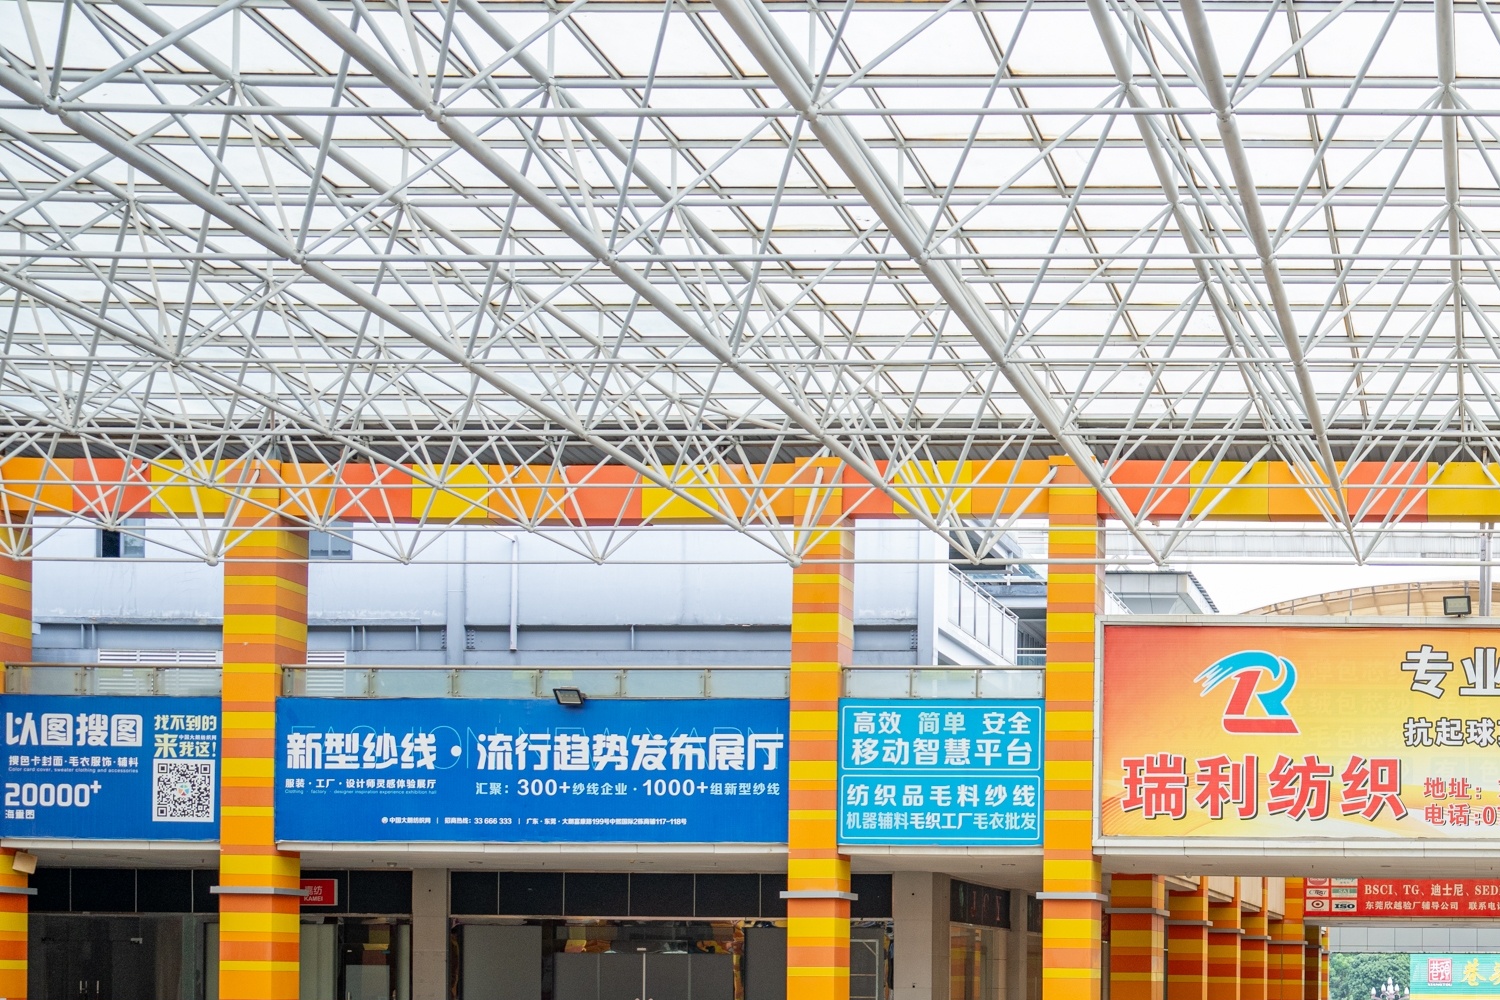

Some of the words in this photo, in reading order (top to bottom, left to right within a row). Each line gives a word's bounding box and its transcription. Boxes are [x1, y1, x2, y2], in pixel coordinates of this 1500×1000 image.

[5, 712, 143, 747] 以图搜图
[154, 714, 217, 731] 找不到的
[853, 711, 901, 734] 高效
[918, 711, 966, 735] 简单
[982, 711, 1031, 735] 安全
[851, 737, 1032, 766] 移动智慧平台
[846, 783, 1035, 807] 纺织品毛料纱线
[1121, 753, 1404, 822] 瑞利纺织
[846, 812, 1036, 830] 机器辅料毛织工厂毛衣批发
